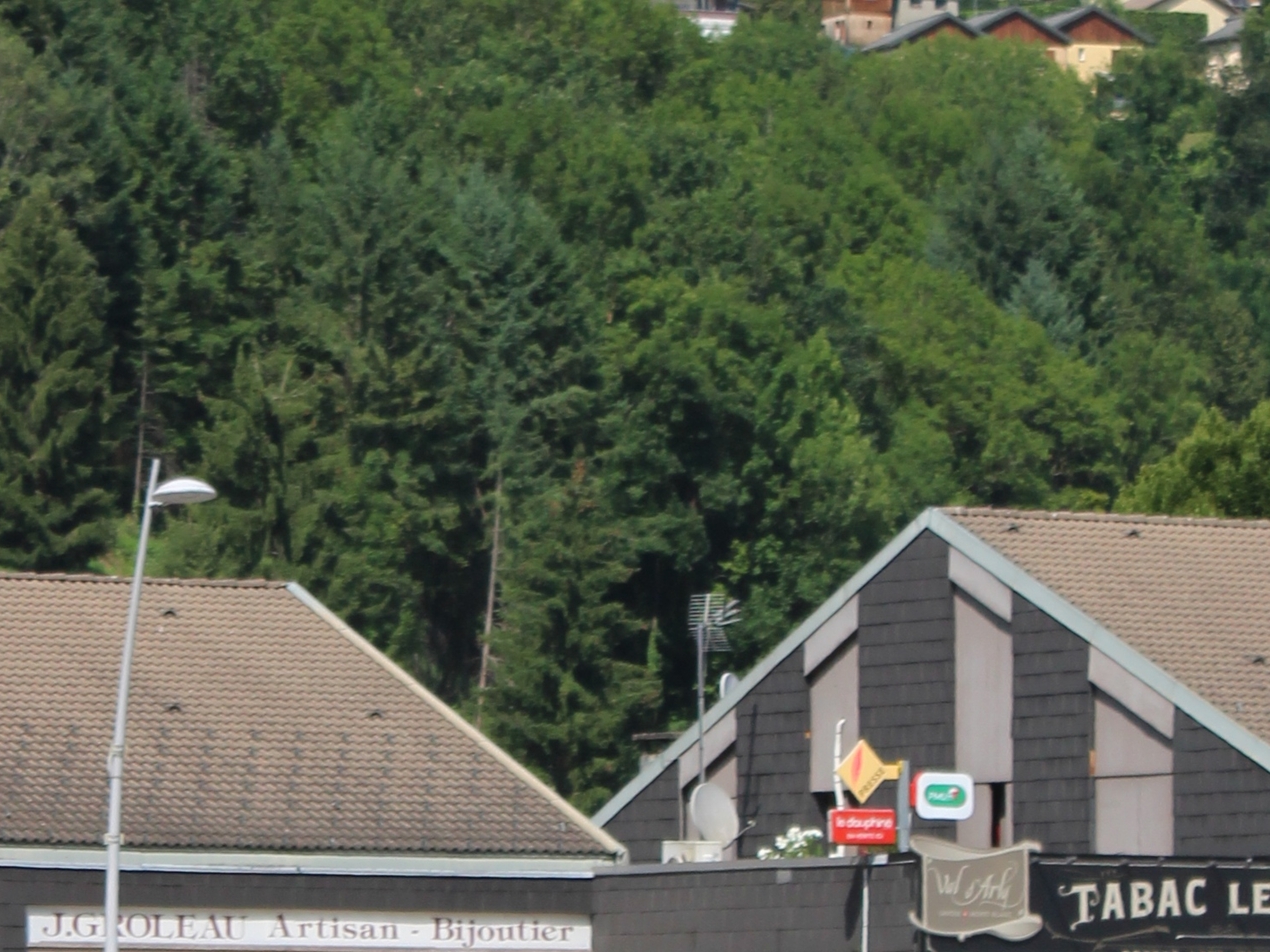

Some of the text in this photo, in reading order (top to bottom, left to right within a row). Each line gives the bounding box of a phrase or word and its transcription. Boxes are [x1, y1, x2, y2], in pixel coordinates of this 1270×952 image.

[857, 766, 887, 797] PRESSE
[928, 865, 969, 895] Val
[1058, 878, 1207, 931] TABAC
[268, 913, 399, 941] Artisan
[432, 917, 574, 947] Bijoutier
